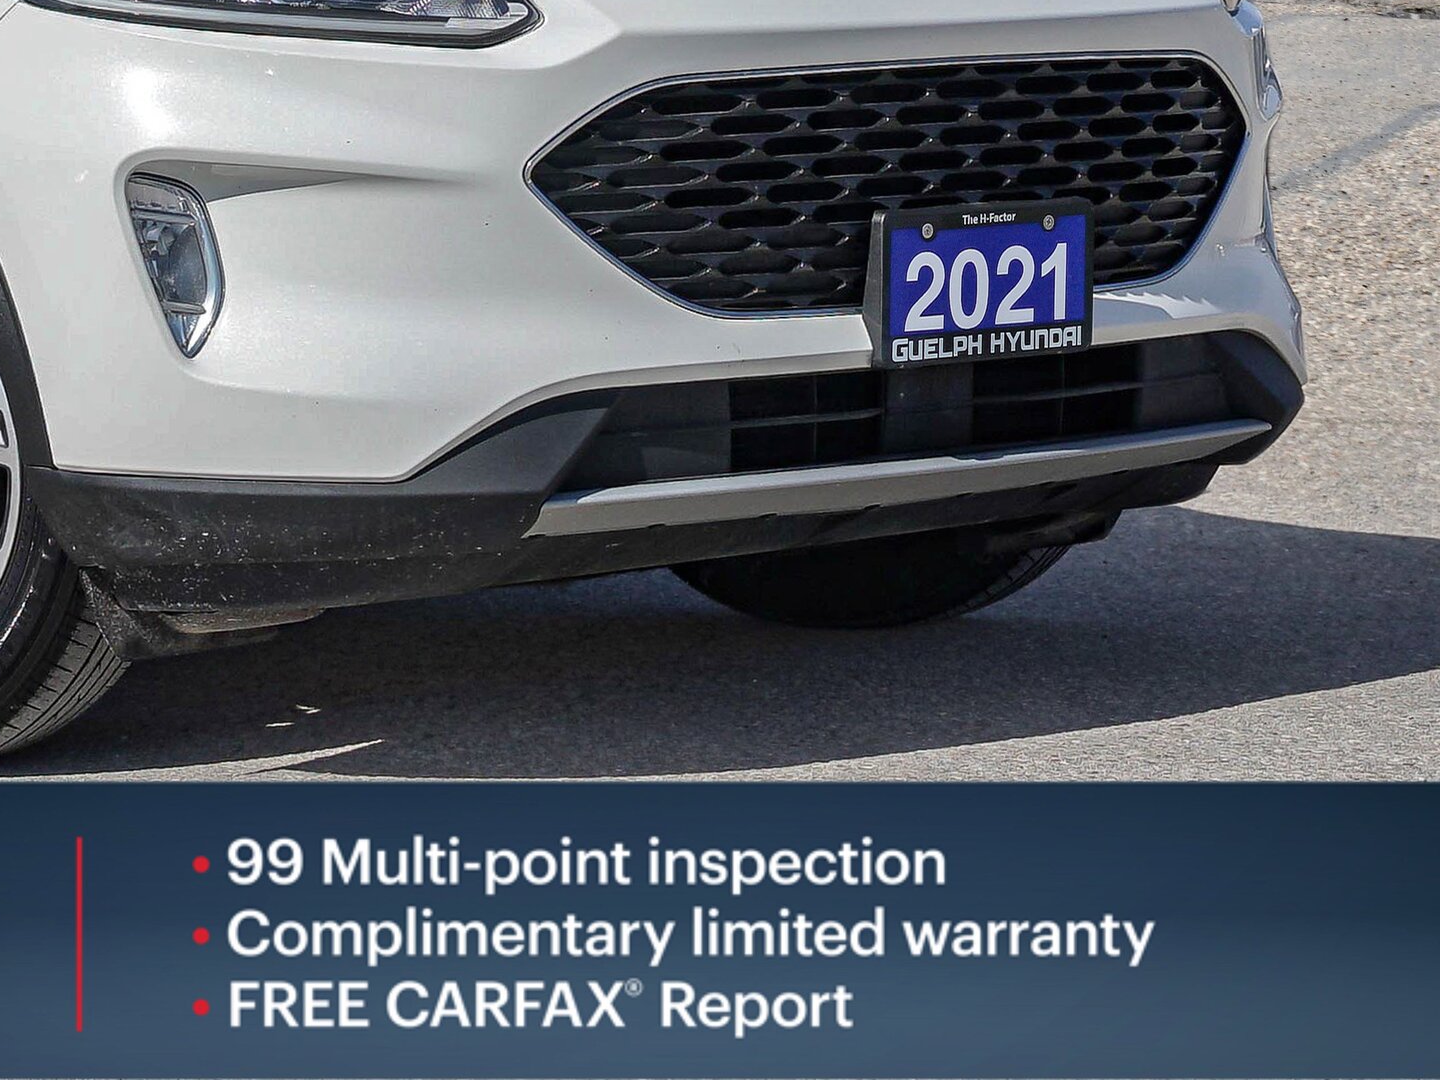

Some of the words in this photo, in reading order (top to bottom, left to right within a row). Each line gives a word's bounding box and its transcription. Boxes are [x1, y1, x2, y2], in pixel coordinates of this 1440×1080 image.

[962, 214, 979, 226] The
[980, 212, 1017, 225] H-Factor
[904, 242, 1068, 333] 2021
[891, 334, 984, 363] GUELPH
[990, 325, 1083, 354] HYUNDAI
